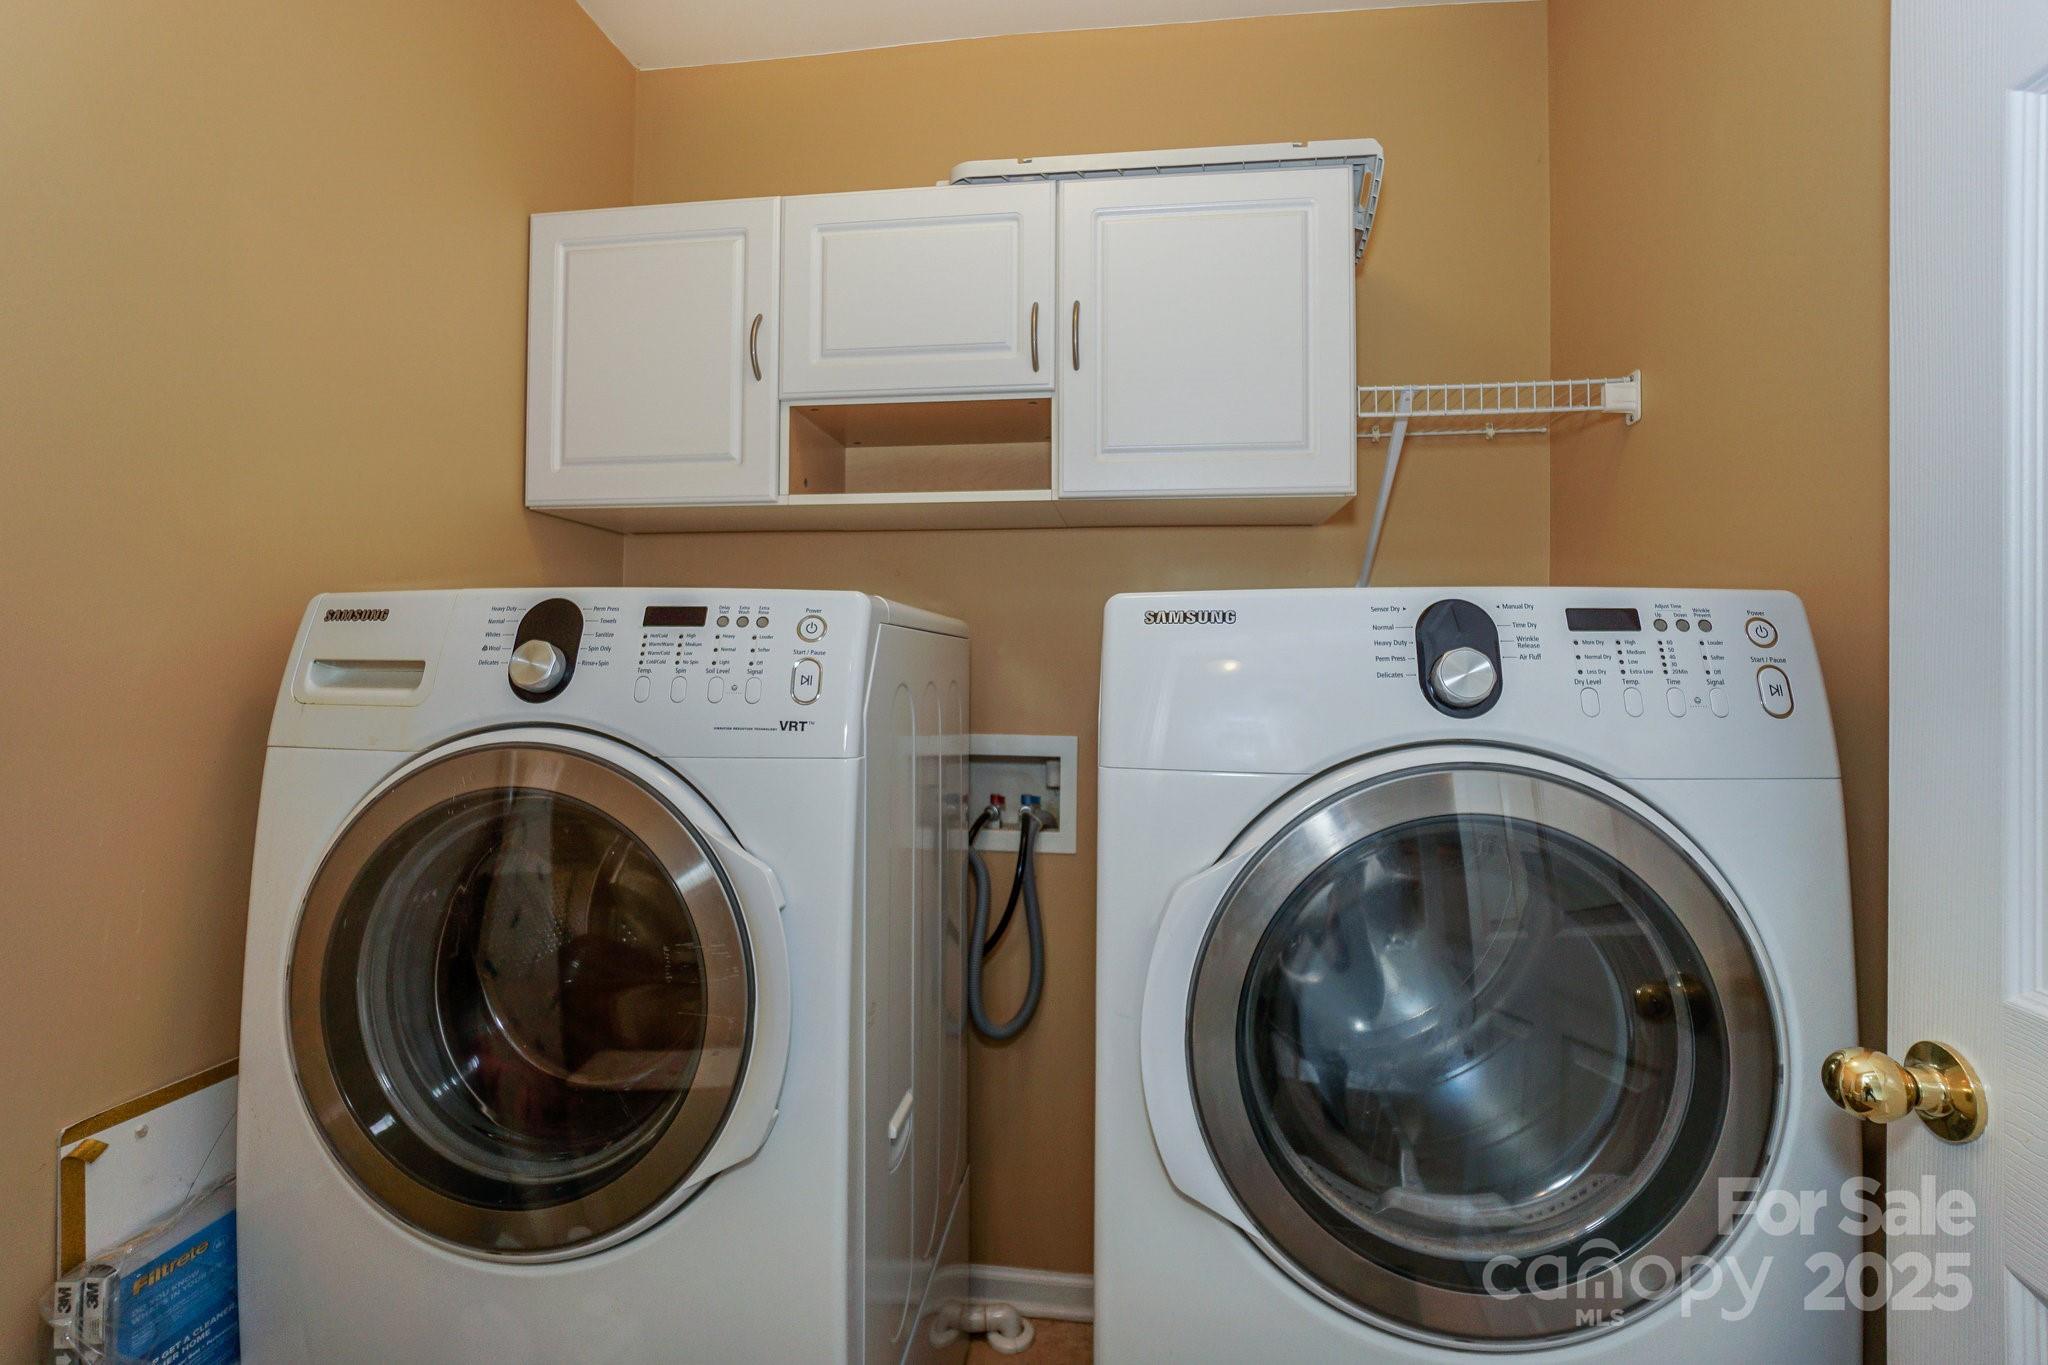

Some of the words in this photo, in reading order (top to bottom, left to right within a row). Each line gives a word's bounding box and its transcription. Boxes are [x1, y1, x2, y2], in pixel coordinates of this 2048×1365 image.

[324, 608, 390, 622] SAMSUNG
[1144, 610, 1236, 624] SAMSUNG
[780, 720, 808, 732] VRT
[132, 1241, 208, 1296] Filtrete
[58, 1286, 72, 1314] 3M
[86, 1282, 99, 1310] 3M
[182, 1328, 212, 1354] HOME
[183, 1334, 190, 1345] A
